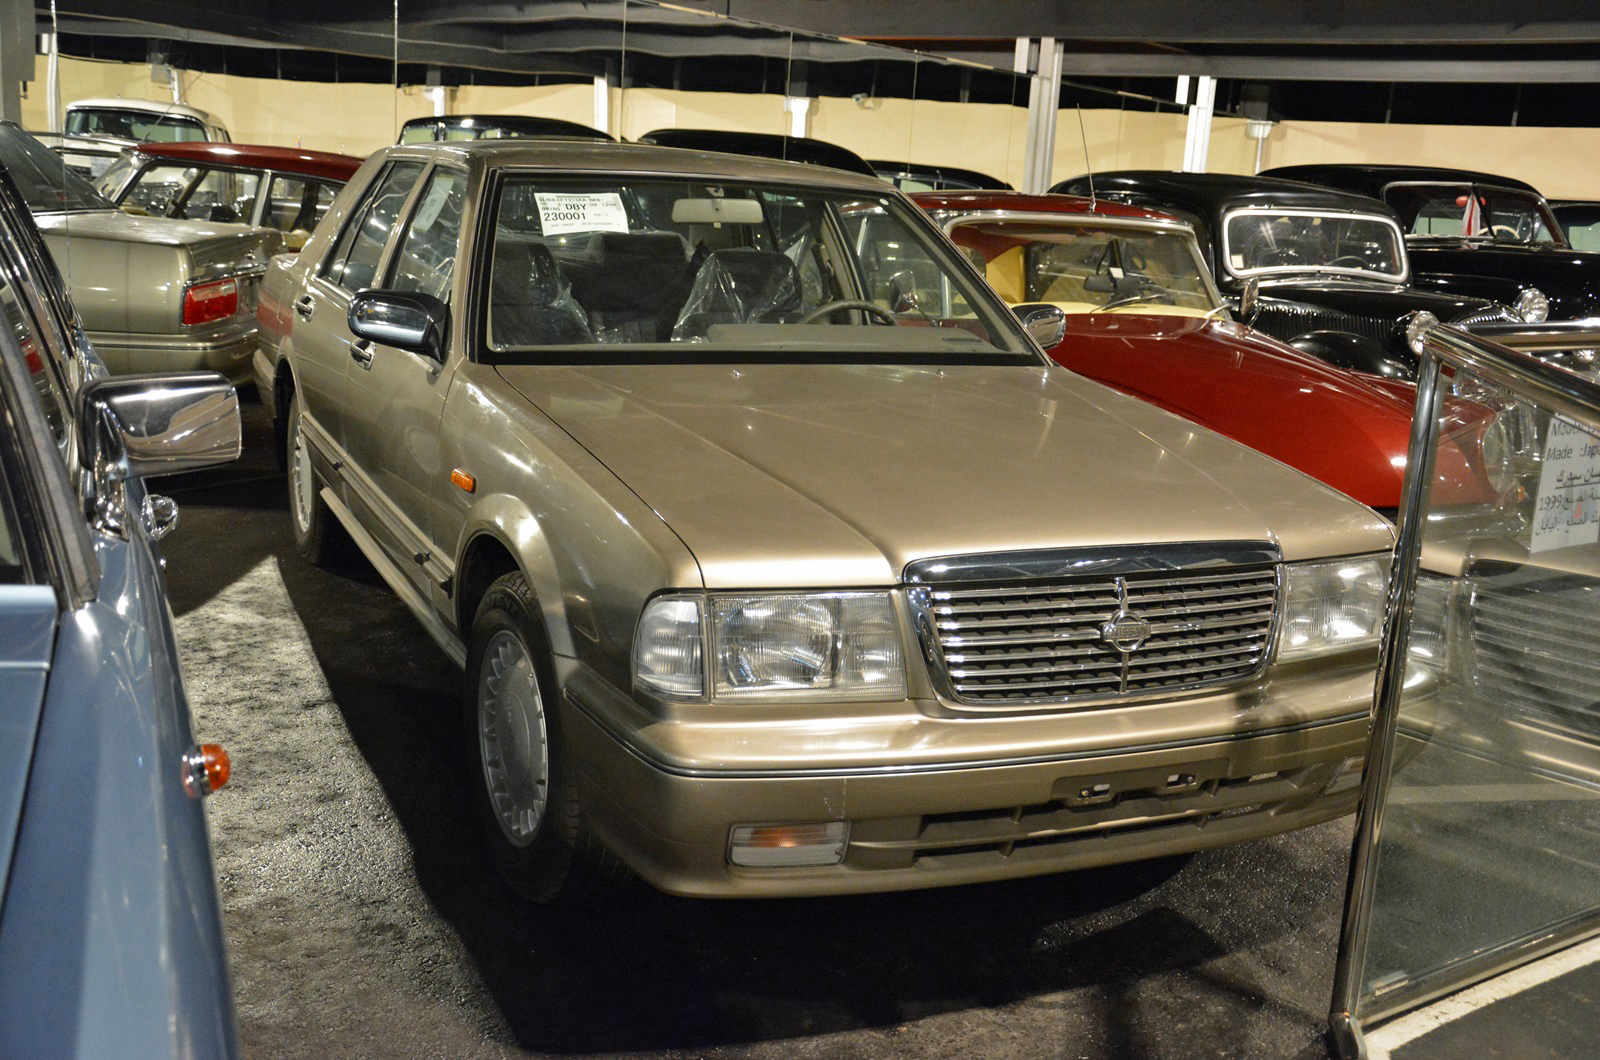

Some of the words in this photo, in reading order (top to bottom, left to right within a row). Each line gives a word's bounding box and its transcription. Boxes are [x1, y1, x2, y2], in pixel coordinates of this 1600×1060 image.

[565, 203, 587, 211] DBY
[544, 212, 586, 222] 230001
[1546, 444, 1573, 461] Made
[1112, 626, 1147, 637] NISSAN
